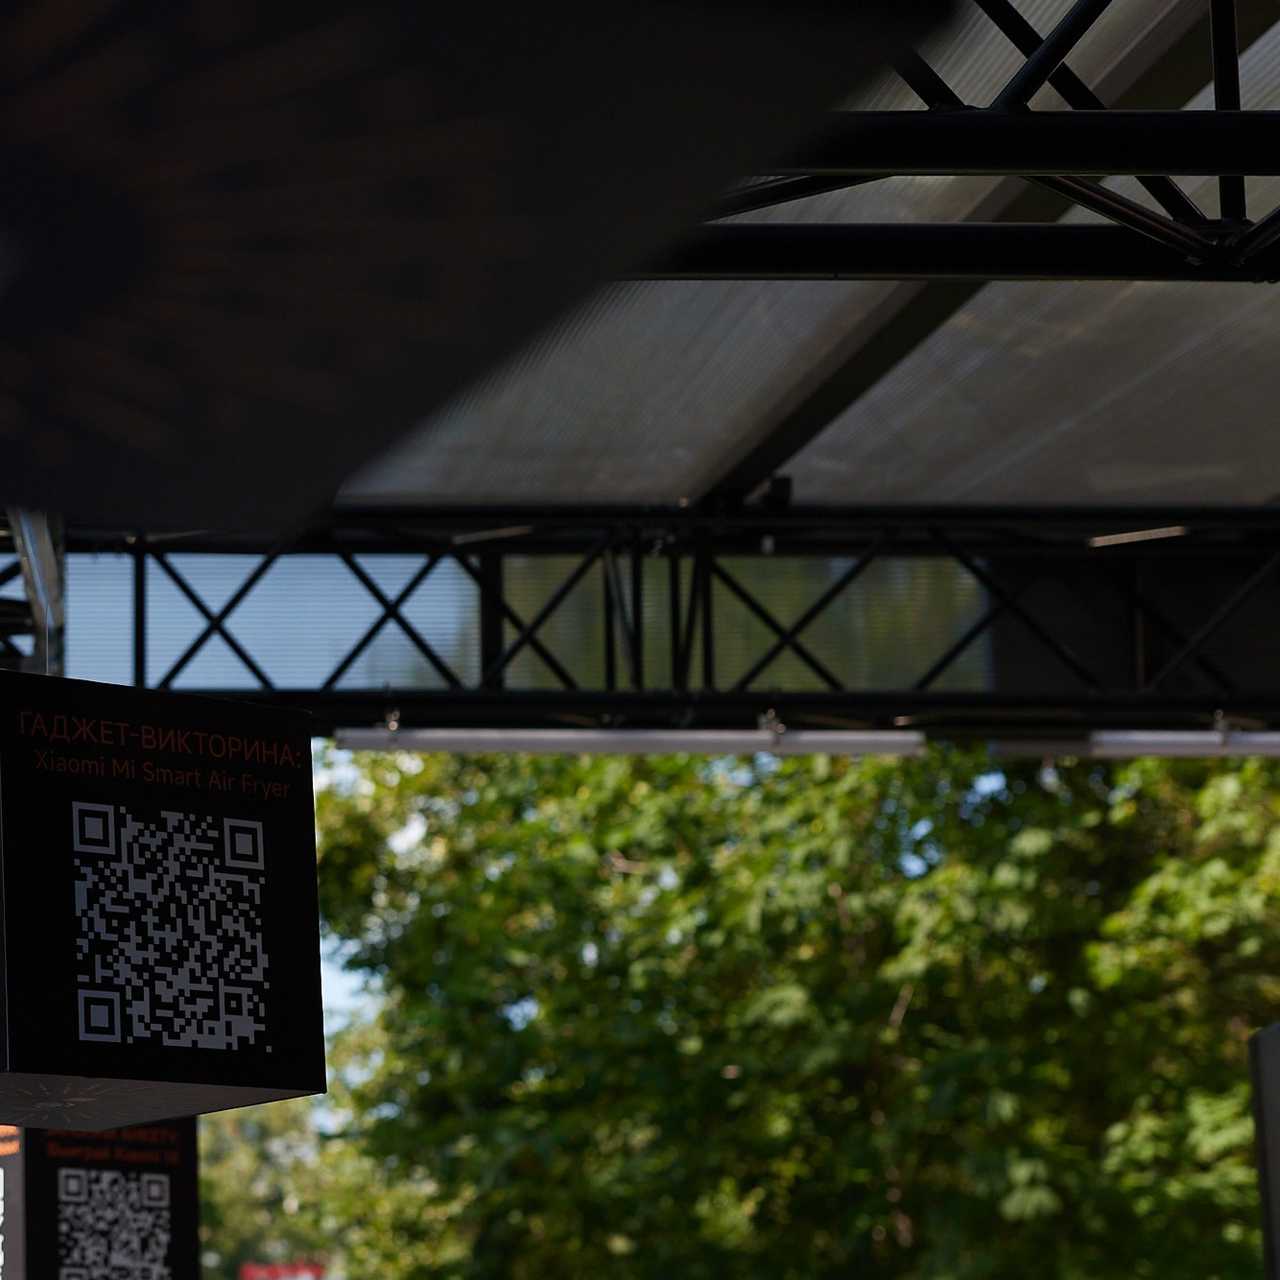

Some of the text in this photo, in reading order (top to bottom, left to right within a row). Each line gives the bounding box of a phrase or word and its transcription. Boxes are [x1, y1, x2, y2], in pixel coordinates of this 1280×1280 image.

[20, 711, 302, 769] ГАДЖЕТ-ВИКТОРИНА:
[35, 749, 291, 801] Xiaomi Mi Smart Air Fryer
